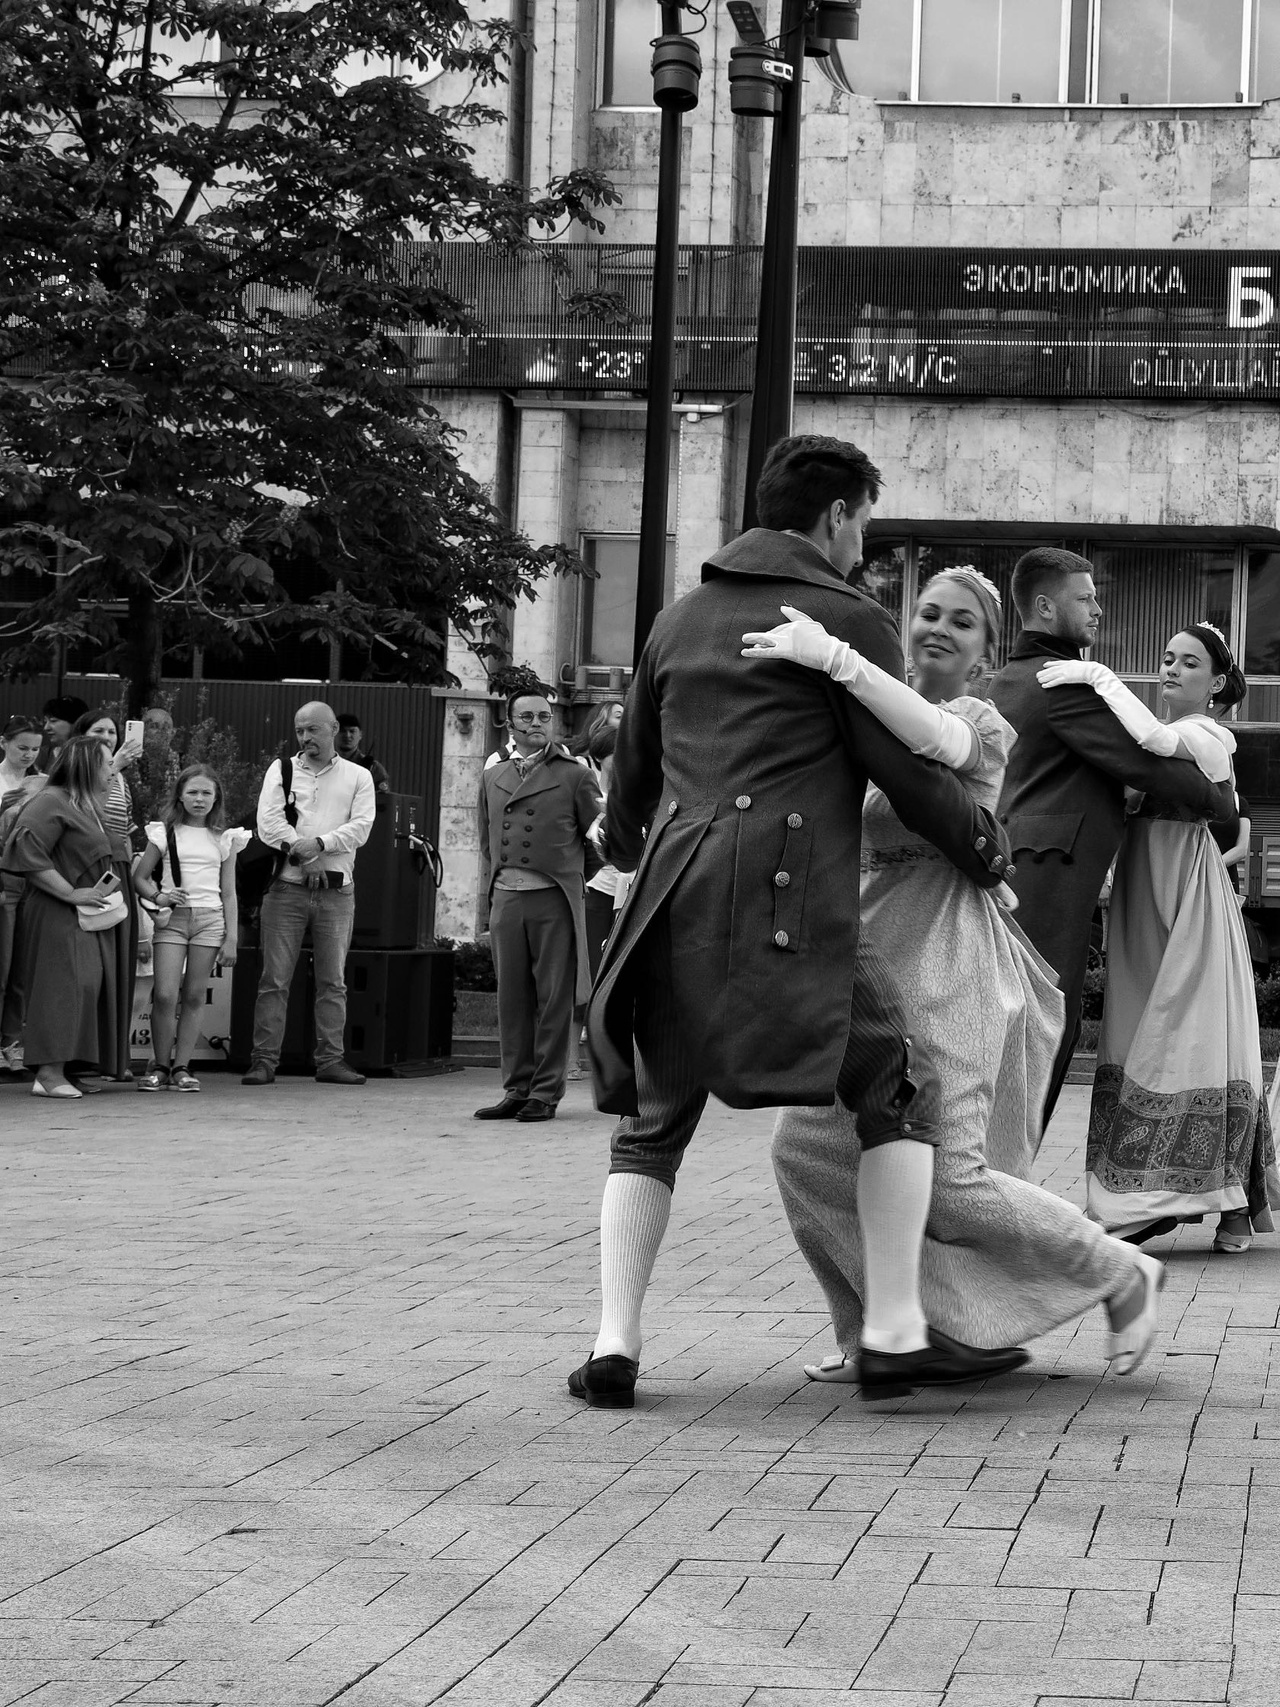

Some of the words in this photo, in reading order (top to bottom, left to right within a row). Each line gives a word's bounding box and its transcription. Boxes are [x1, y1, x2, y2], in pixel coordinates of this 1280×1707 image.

[962, 263, 1186, 295] ЭКОНОМИКА
[573, 350, 646, 379] +23°
[887, 353, 957, 389] М/С
